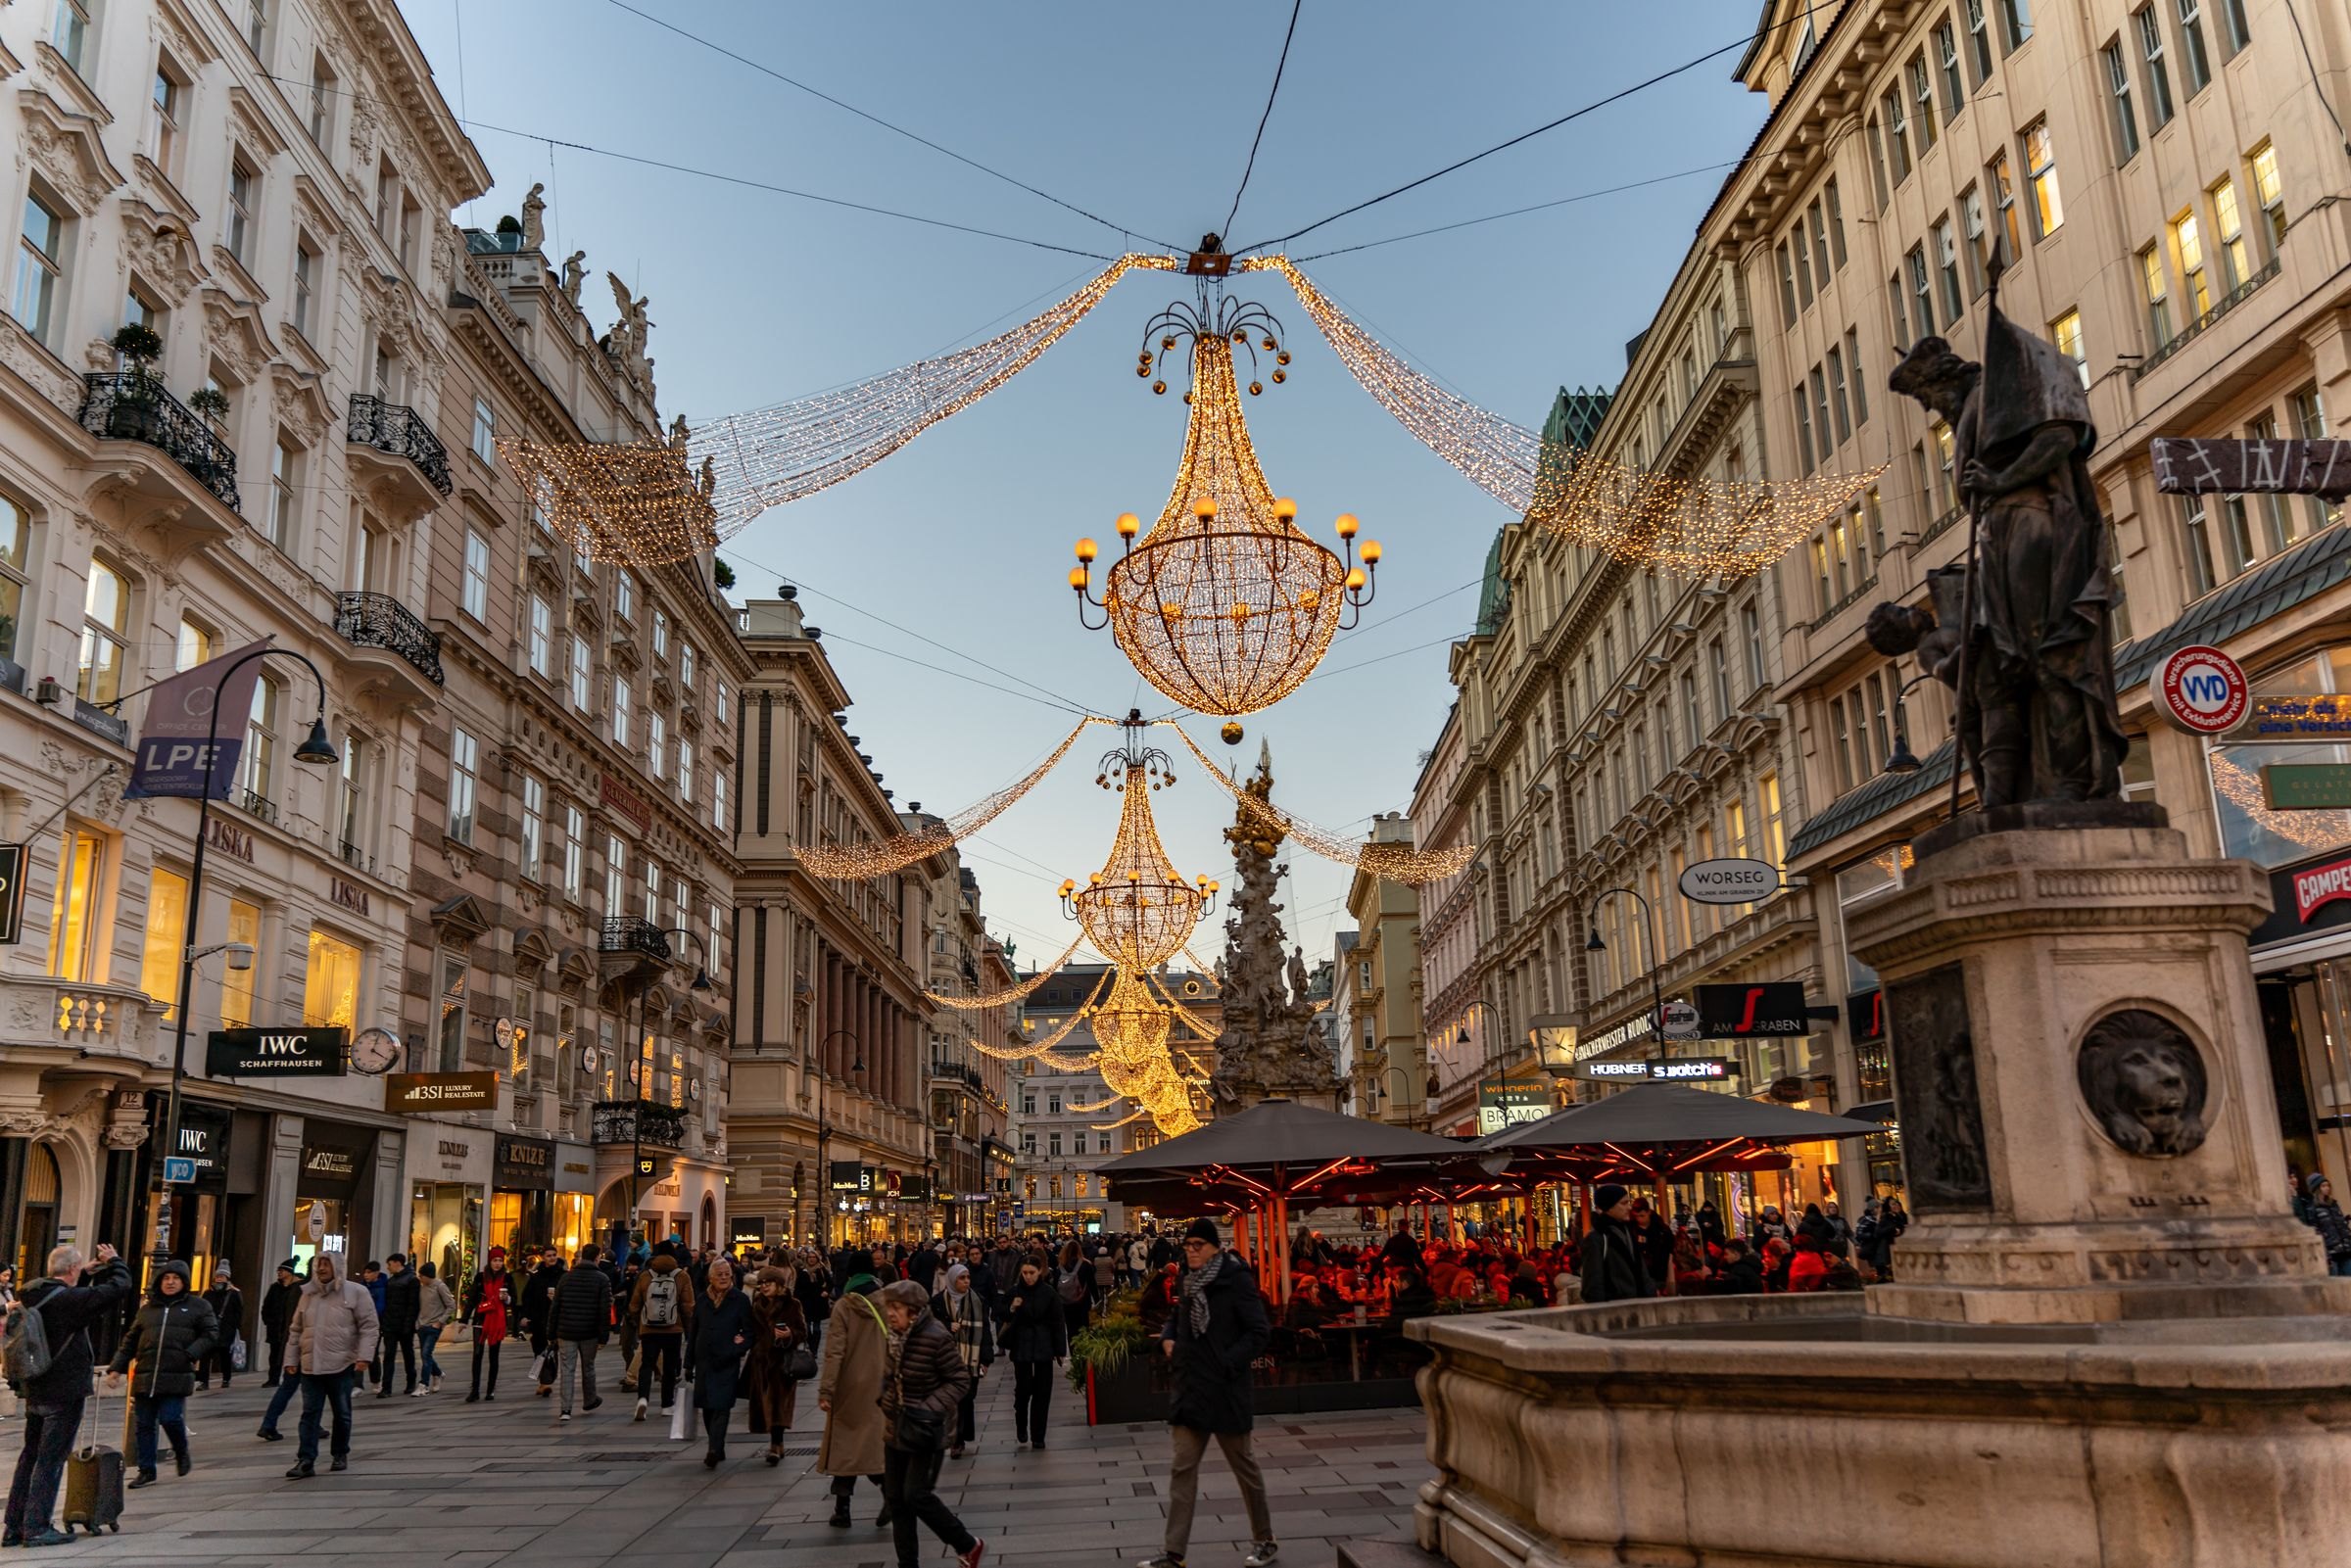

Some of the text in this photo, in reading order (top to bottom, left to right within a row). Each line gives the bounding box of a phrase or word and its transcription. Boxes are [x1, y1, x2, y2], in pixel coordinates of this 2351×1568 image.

[2167, 652, 2241, 687] Versicherungsdienst
[2171, 691, 2242, 727] mit Exklusivservice
[157, 722, 188, 731] OFFICE
[2258, 720, 2293, 734] eine
[145, 744, 221, 771] LPE
[204, 815, 255, 864] LISKA
[1695, 871, 1764, 884] WORSEG
[330, 878, 370, 917] LISKA
[1712, 1019, 1800, 1033] AM GRABEN
[258, 1035, 308, 1055] IWC
[239, 1060, 322, 1069] SCHAFFHAUSEN
[125, 1092, 137, 1103] 12
[420, 1085, 443, 1100] 3SI
[1487, 1109, 1545, 1122] BRAMO
[178, 1128, 207, 1152] IWC
[510, 1144, 546, 1165] KNIZE
